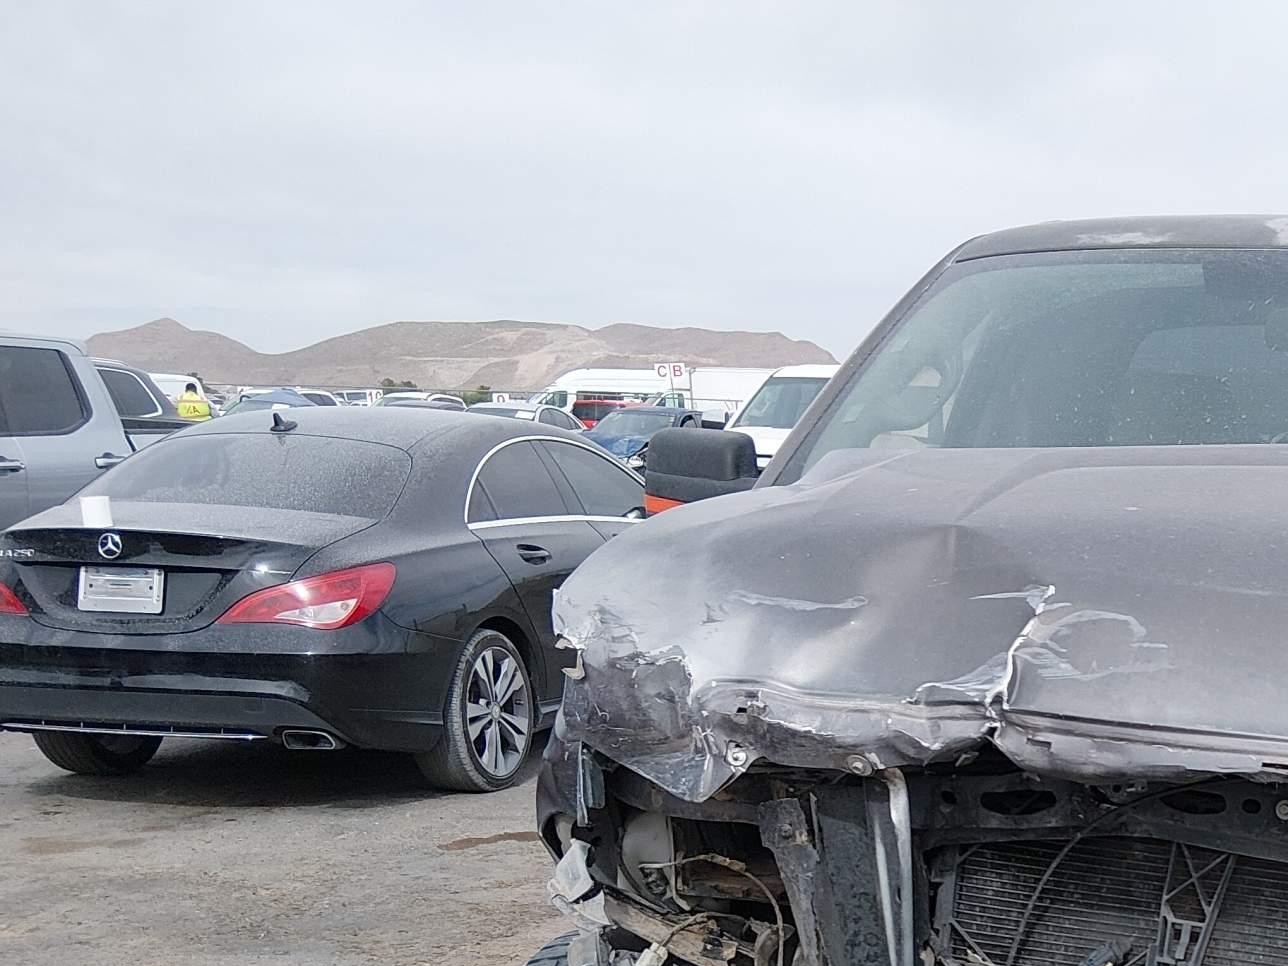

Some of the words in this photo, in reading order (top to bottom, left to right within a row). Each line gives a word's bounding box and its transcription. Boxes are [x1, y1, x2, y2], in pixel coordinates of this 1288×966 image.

[657, 365, 668, 378] C
[672, 364, 683, 377] B
[0, 549, 35, 557] LA250
